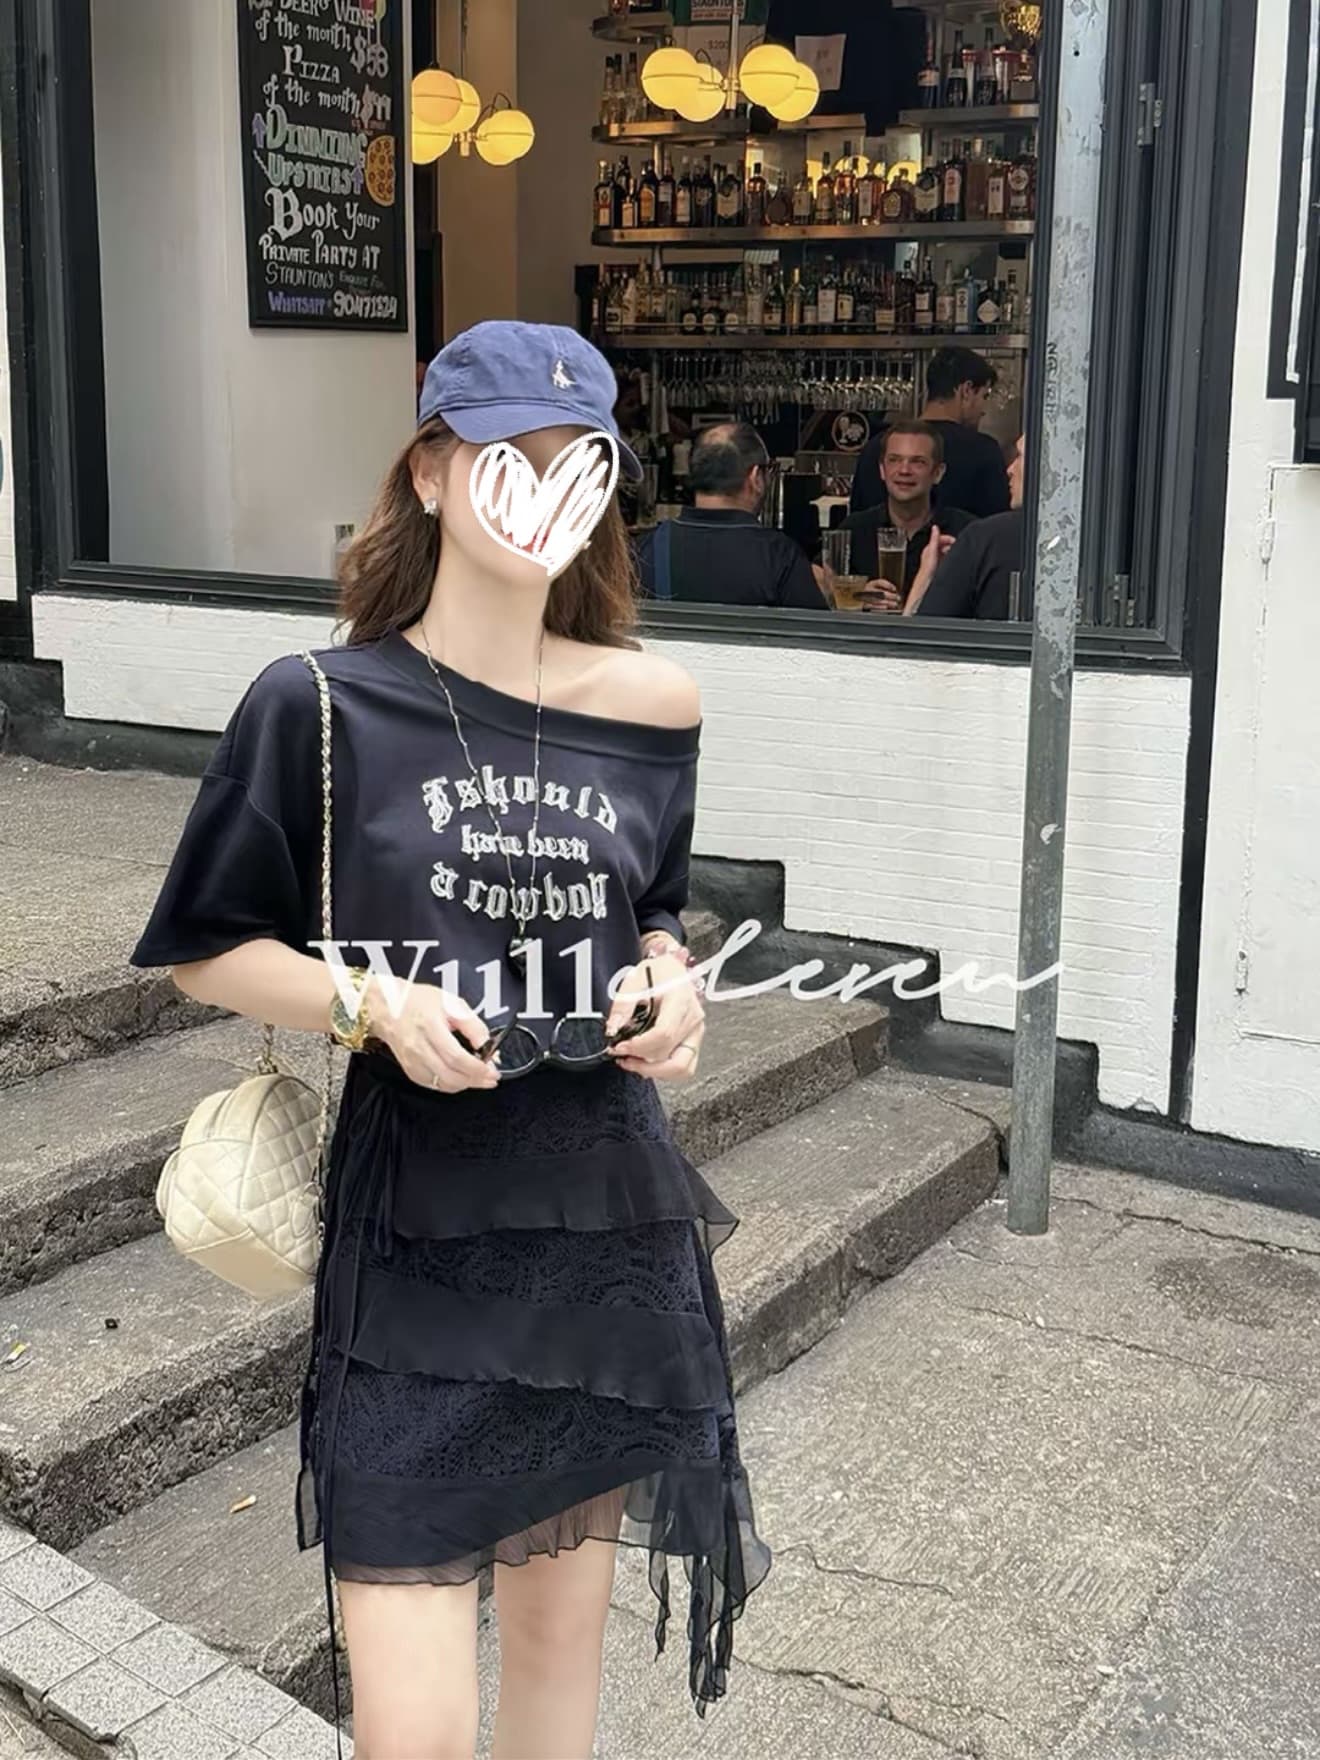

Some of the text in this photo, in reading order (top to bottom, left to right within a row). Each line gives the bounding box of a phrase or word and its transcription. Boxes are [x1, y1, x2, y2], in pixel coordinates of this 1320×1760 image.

[255, 10, 270, 41] of
[274, 11, 300, 40] the
[306, 22, 352, 52] month
[262, 73, 279, 108] of
[284, 77, 311, 107] the
[318, 87, 360, 119] month
[527, 827, 590, 865] been
